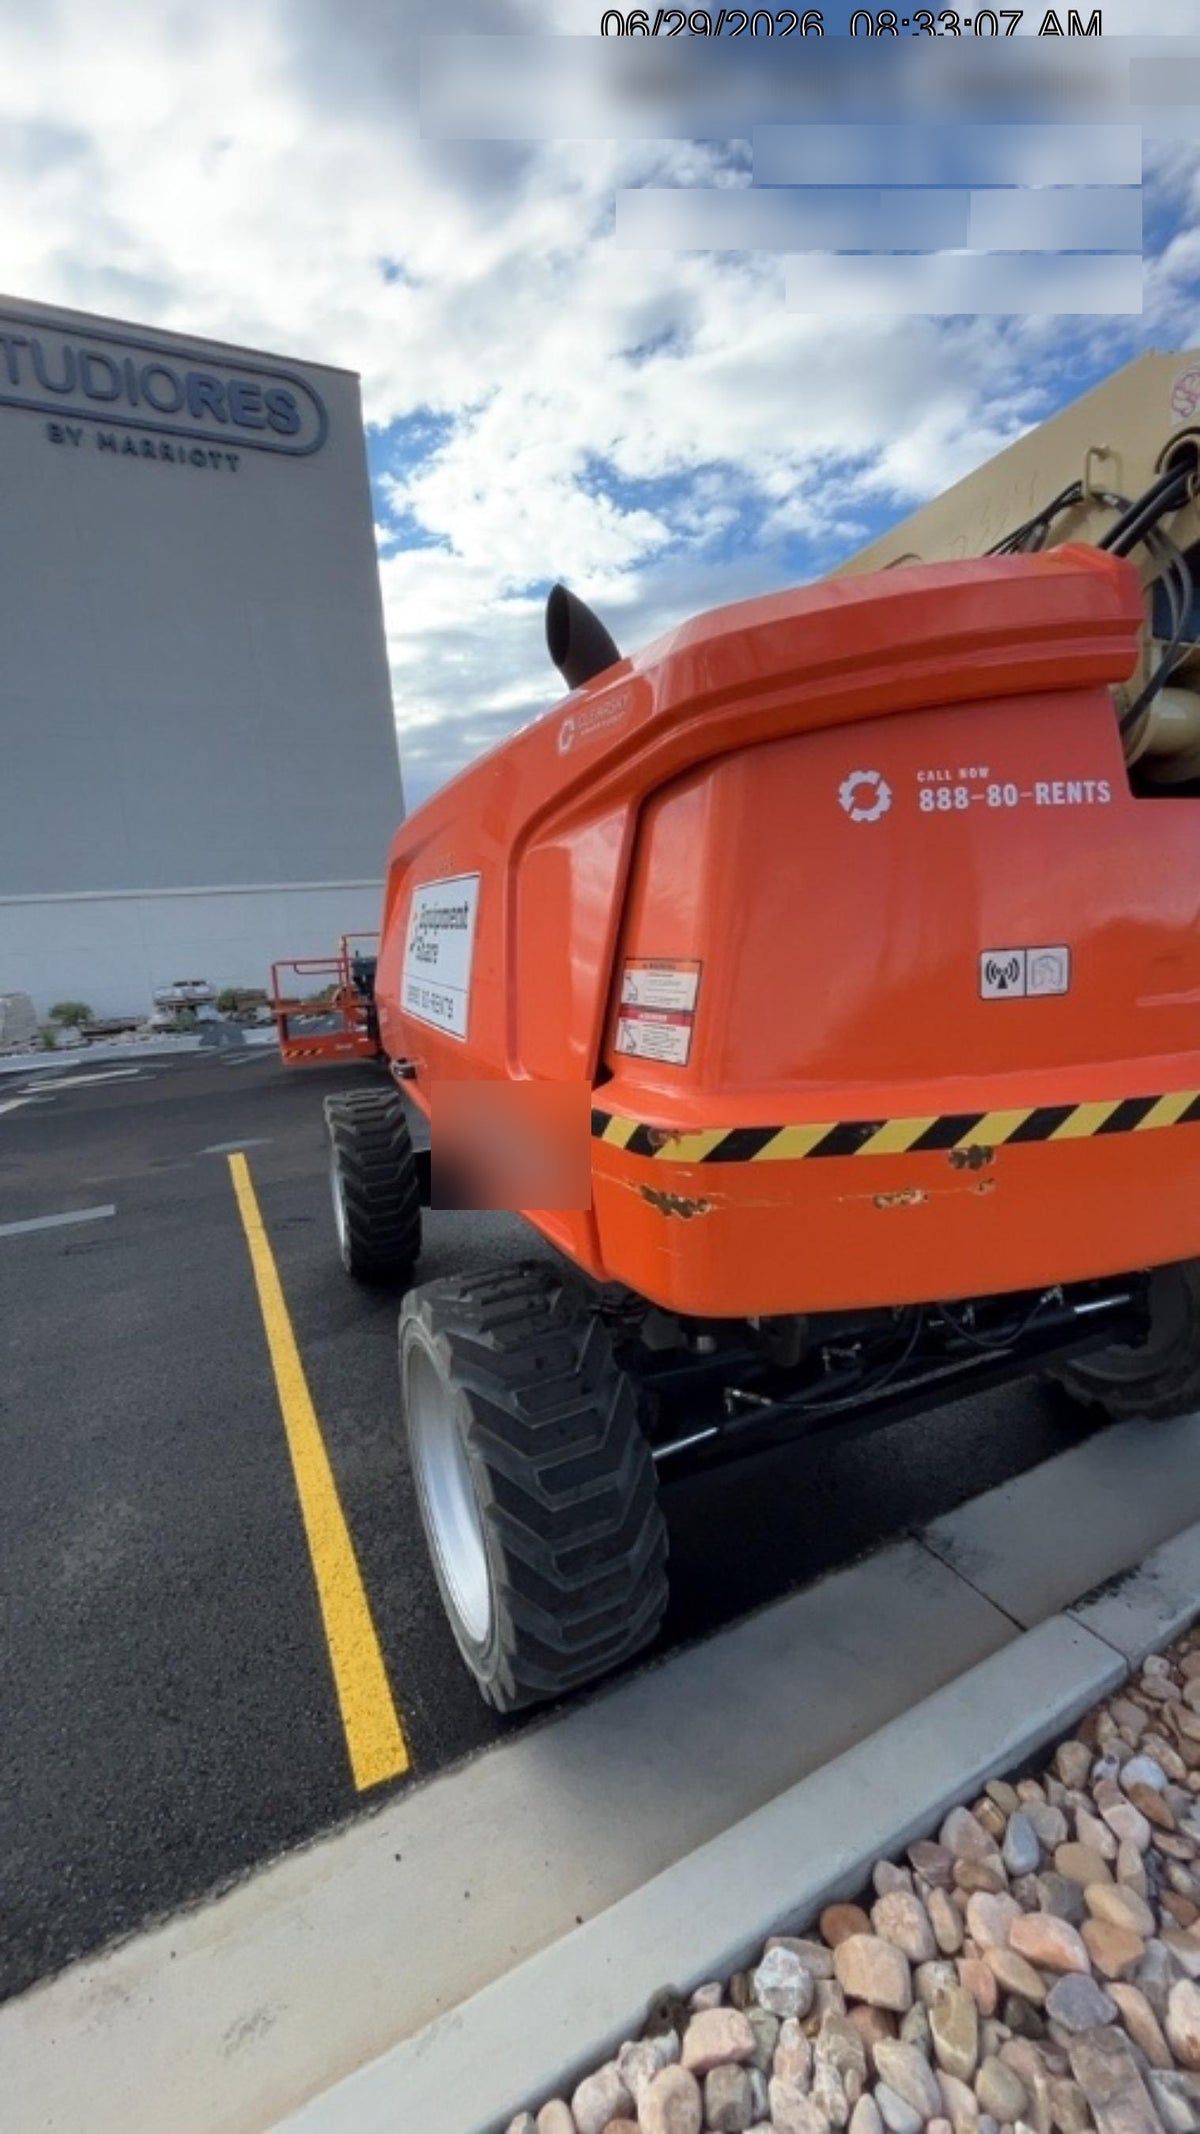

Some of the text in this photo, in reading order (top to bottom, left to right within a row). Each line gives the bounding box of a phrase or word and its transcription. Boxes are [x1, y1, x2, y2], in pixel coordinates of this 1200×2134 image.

[47, 421, 240, 472] BY MARRIOTT
[917, 767, 990, 782] CALL NOW
[919, 779, 1111, 812] 888-80-RENTS
